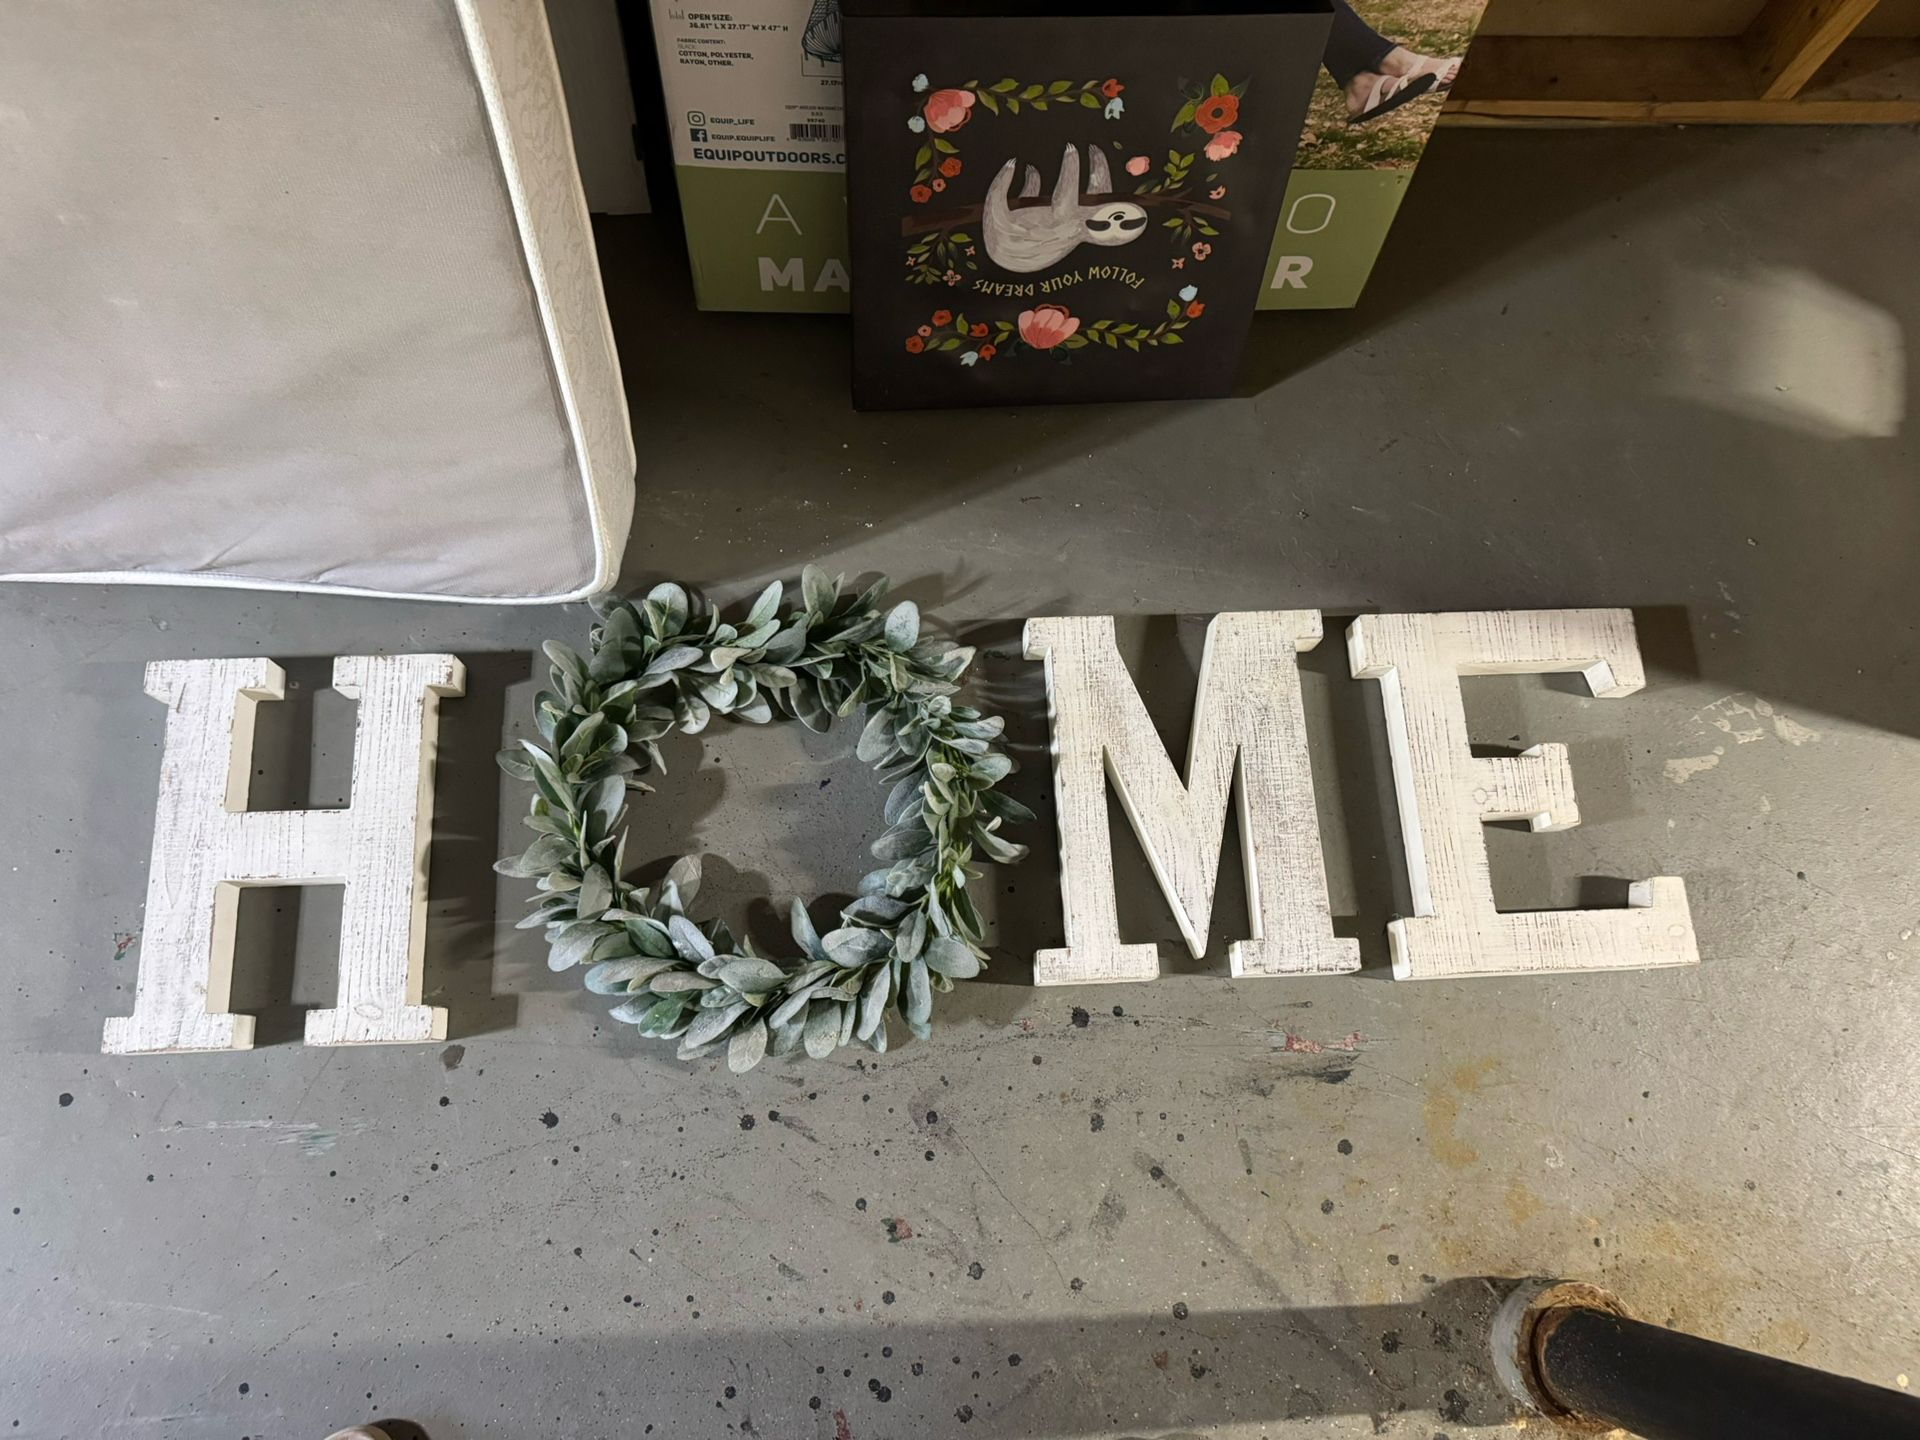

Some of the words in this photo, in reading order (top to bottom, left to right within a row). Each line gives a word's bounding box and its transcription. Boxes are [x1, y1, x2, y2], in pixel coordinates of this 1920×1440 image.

[688, 13, 711, 21] OPEN
[678, 50, 709, 58] COTTON,
[710, 51, 754, 60] POLYESTER,
[680, 58, 707, 66] RAYON,
[707, 59, 734, 67] OTHER.
[709, 117, 755, 126] EQUIP_LIFE
[711, 133, 776, 142] EQUIP.EQUIPLIFE
[1040, 270, 1083, 294] YOUR
[1088, 266, 1145, 289] FOLLOW
[972, 279, 1035, 297] DREAMS
